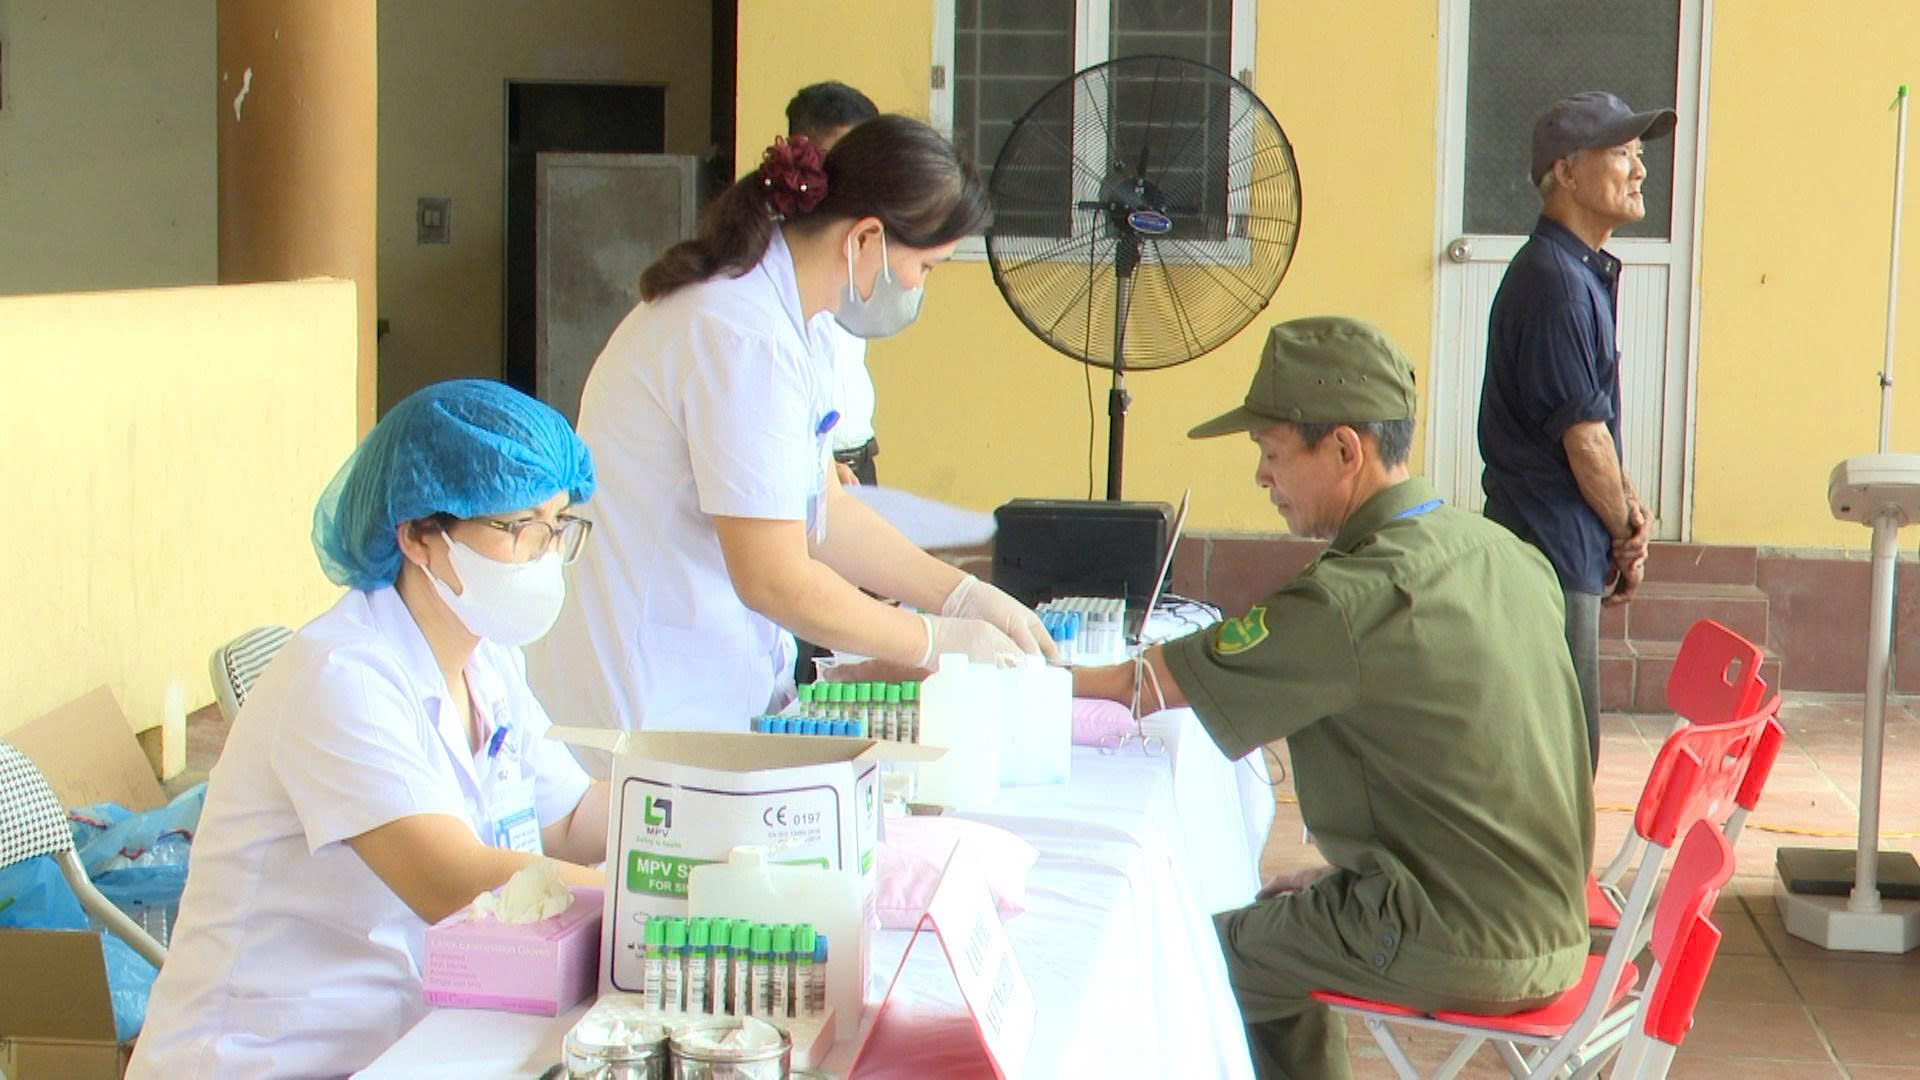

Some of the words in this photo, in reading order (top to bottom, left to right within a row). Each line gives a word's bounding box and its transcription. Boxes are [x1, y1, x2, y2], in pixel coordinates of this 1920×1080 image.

[763, 805, 787, 828] CE
[793, 812, 821, 825] 0197
[646, 826, 669, 838] MPV
[636, 858, 672, 877] MPV
[648, 878, 672, 891] FOR
